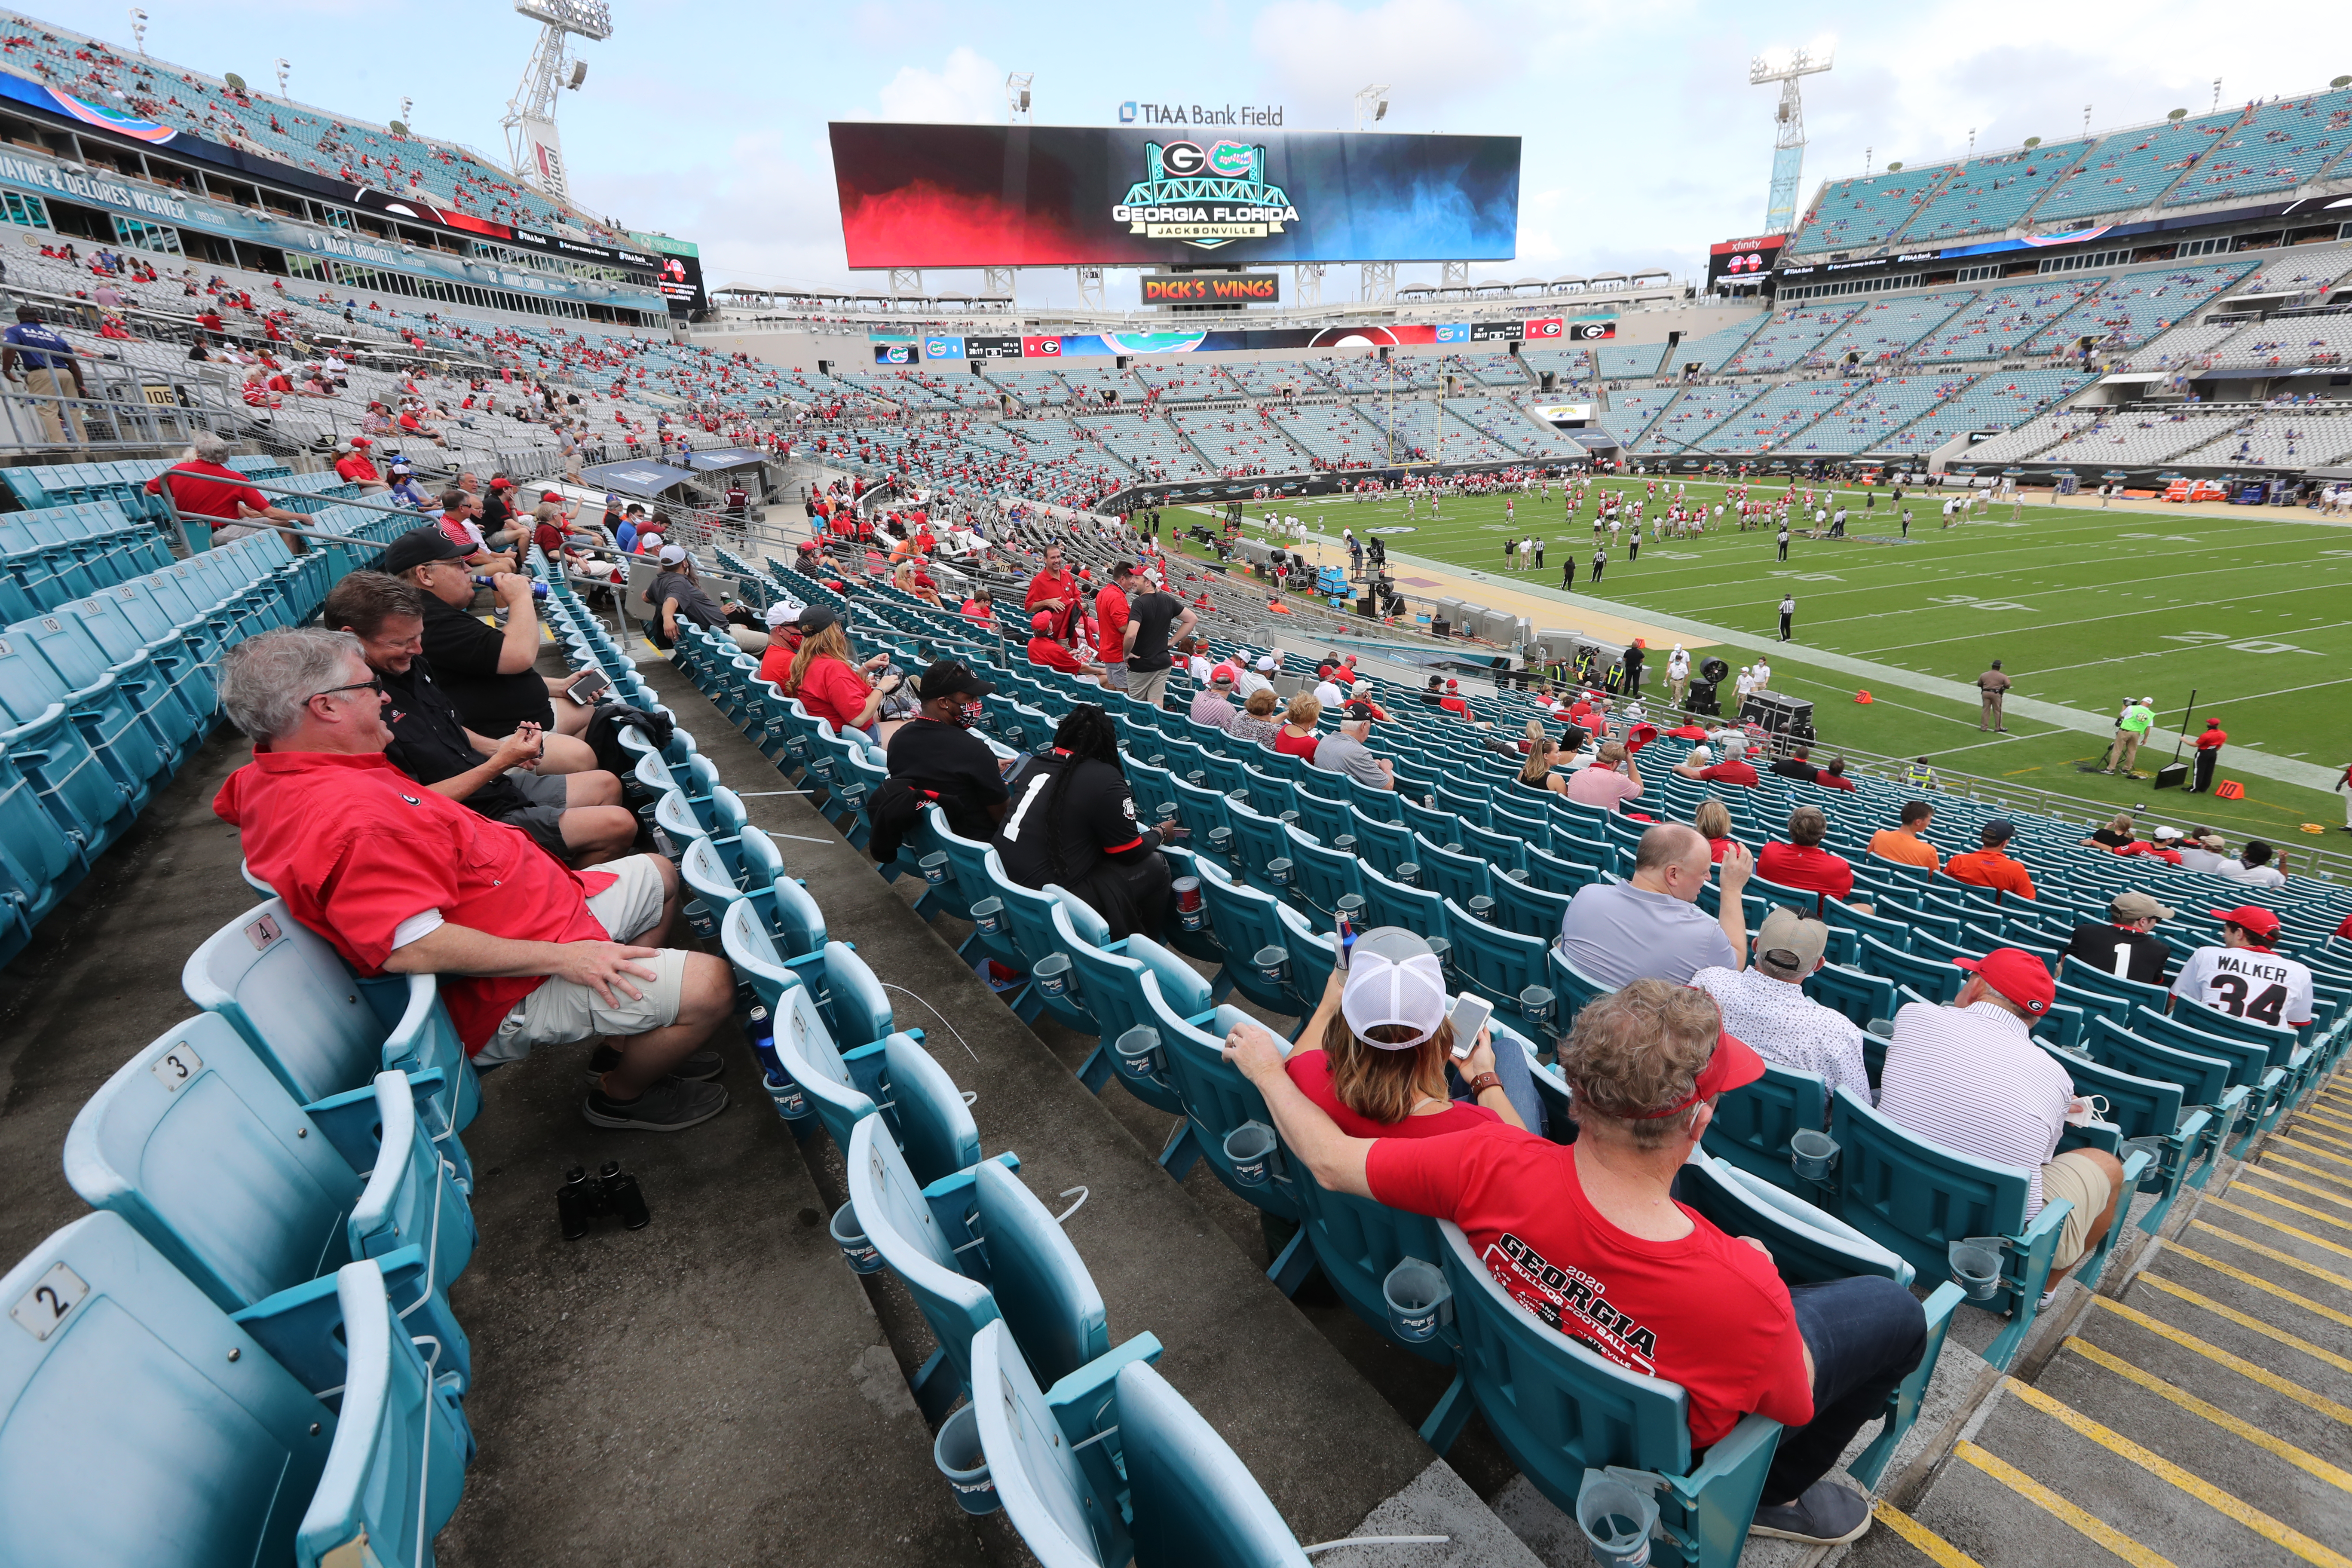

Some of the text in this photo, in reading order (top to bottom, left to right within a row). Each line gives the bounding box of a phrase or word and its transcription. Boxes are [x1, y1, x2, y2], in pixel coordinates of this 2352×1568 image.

[230, 76, 242, 87] 415
[1141, 104, 1283, 126] TIAA Bank Field
[49, 169, 65, 191] &
[63, 172, 131, 207] DELORES
[130, 190, 187, 220] WEAVER
[194, 210, 227, 226] 1993-2011
[1112, 205, 1299, 221] GEORGIA FLORIDA
[1158, 227, 1256, 235] JACKSONVILLE
[523, 232, 547, 245] TIAA Bank
[307, 233, 317, 249] 8
[322, 236, 354, 257] MARK
[353, 243, 397, 265] BRUNELL
[652, 239, 689, 254] XBOX ONE
[1731, 240, 1762, 252] xfinity
[624, 253, 646, 263] TIAA Bank
[487, 270, 499, 284] 82
[502, 272, 524, 288] JIMMY
[524, 276, 545, 291] SMITH
[1212, 279, 1274, 298] WINGS
[146, 391, 174, 404] 106
[1642, 550, 1703, 560] 50
[151, 577, 161, 585] 13
[121, 588, 132, 597] 12
[87, 602, 98, 612] 11
[45, 619, 58, 631] 10
[2157, 631, 2302, 653] 20
[1855, 692, 1867, 701] 20
[2219, 783, 2239, 797] 10
[671, 803, 679, 815] 6
[1003, 772, 1050, 842] 1
[698, 854, 707, 868] 5
[689, 917, 710, 926] PEPSI
[977, 917, 994, 926] PEPSI
[258, 921, 273, 940] 4
[2113, 943, 2132, 978] 1
[1262, 967, 1280, 975] PEPSI
[2217, 955, 2288, 983] WALKER
[1041, 977, 1060, 986] PEPSI
[2027, 999, 2043, 1011] G
[2210, 974, 2288, 1027] 34
[795, 1016, 805, 1033] 3
[167, 1055, 188, 1078] 3
[1126, 1056, 1149, 1068] PEPSI
[774, 1092, 802, 1105] PEPSI
[873, 1159, 884, 1179] 2
[1236, 1162, 1263, 1175] PEPSI
[843, 1245, 873, 1257] PEPS
[1565, 1265, 1606, 1295] 2020
[35, 1286, 70, 1319] 2
[1499, 1233, 1657, 1360] GEORGIA
[1511, 1262, 1564, 1308] BULLDOG
[1565, 1304, 1627, 1355] FOOTBALL
[1403, 1313, 1435, 1327] PEPSI
[1004, 1393, 1017, 1415] 1
